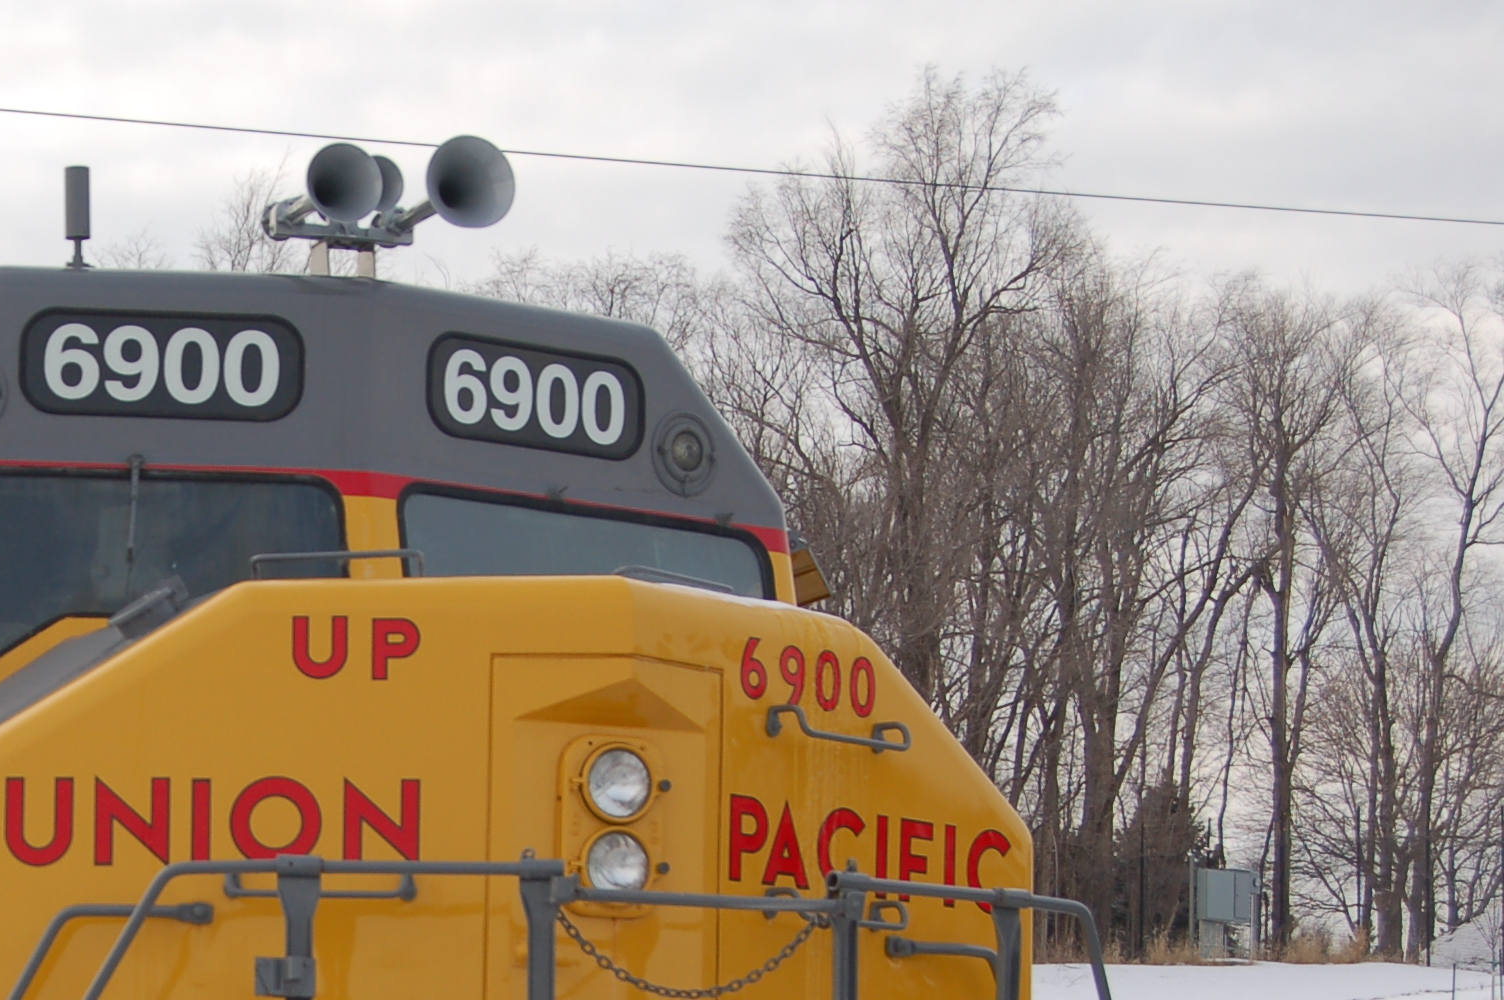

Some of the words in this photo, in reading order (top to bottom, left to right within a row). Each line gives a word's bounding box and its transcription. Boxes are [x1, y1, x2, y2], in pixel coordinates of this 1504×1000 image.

[43, 322, 281, 407] 6900
[443, 348, 626, 446] 6900
[292, 615, 421, 680] UP
[739, 636, 877, 718] 6900
[4, 775, 421, 867] UNION
[728, 793, 1012, 915] PACIFIC
